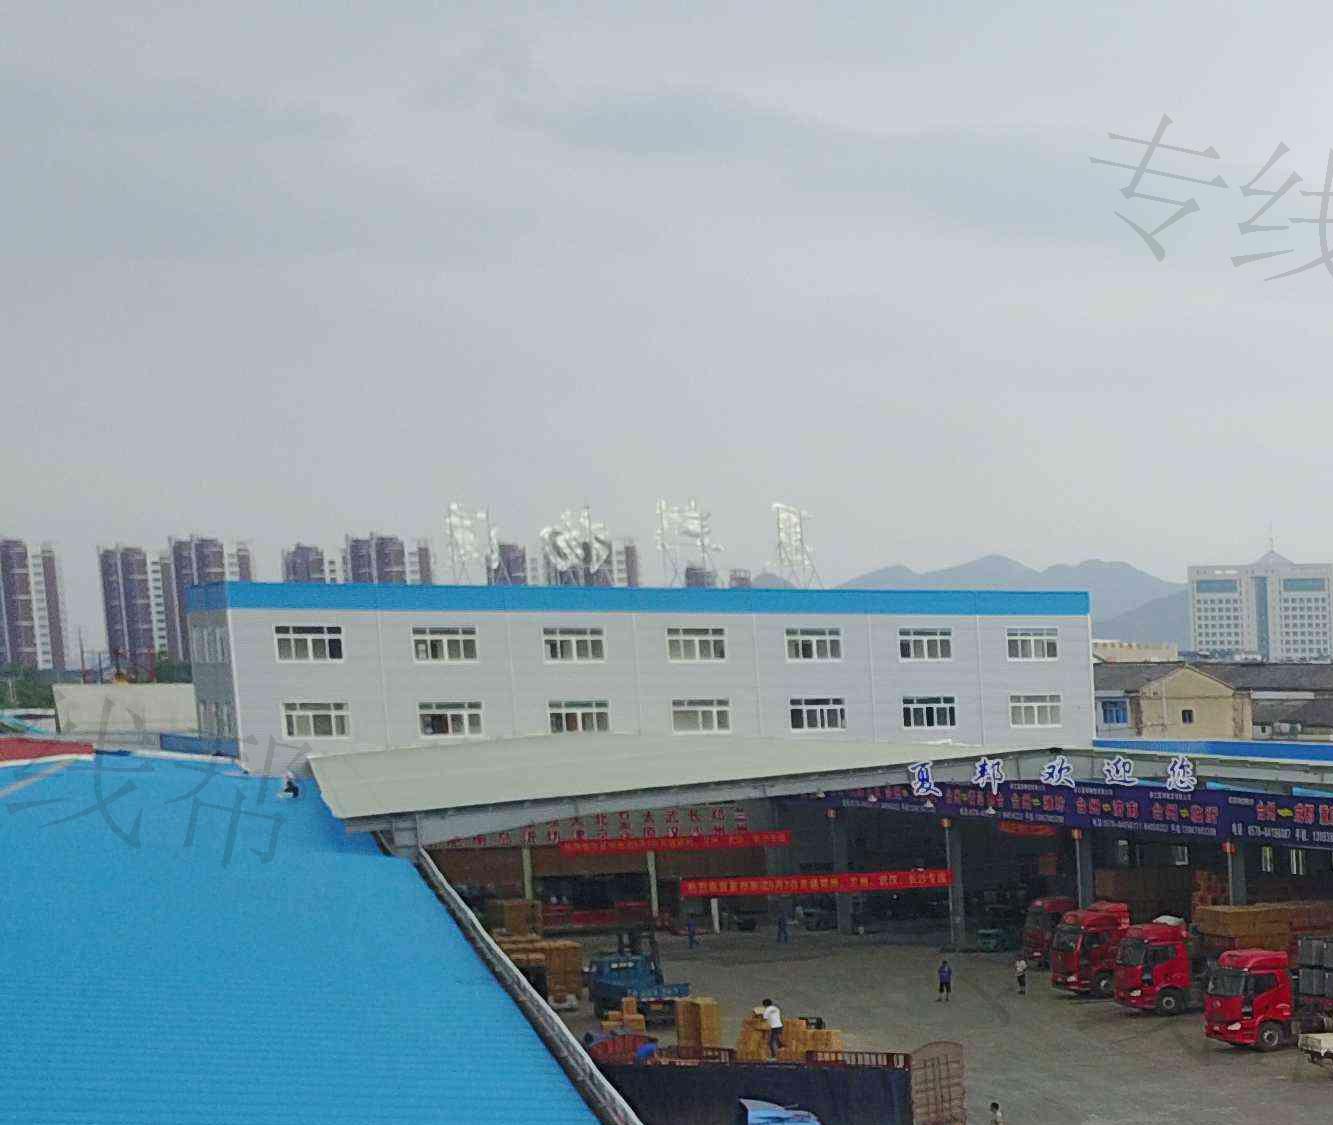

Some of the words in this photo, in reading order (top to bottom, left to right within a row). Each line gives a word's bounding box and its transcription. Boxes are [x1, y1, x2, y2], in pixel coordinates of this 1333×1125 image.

[908, 755, 1198, 797] 夏邦欢迎您
